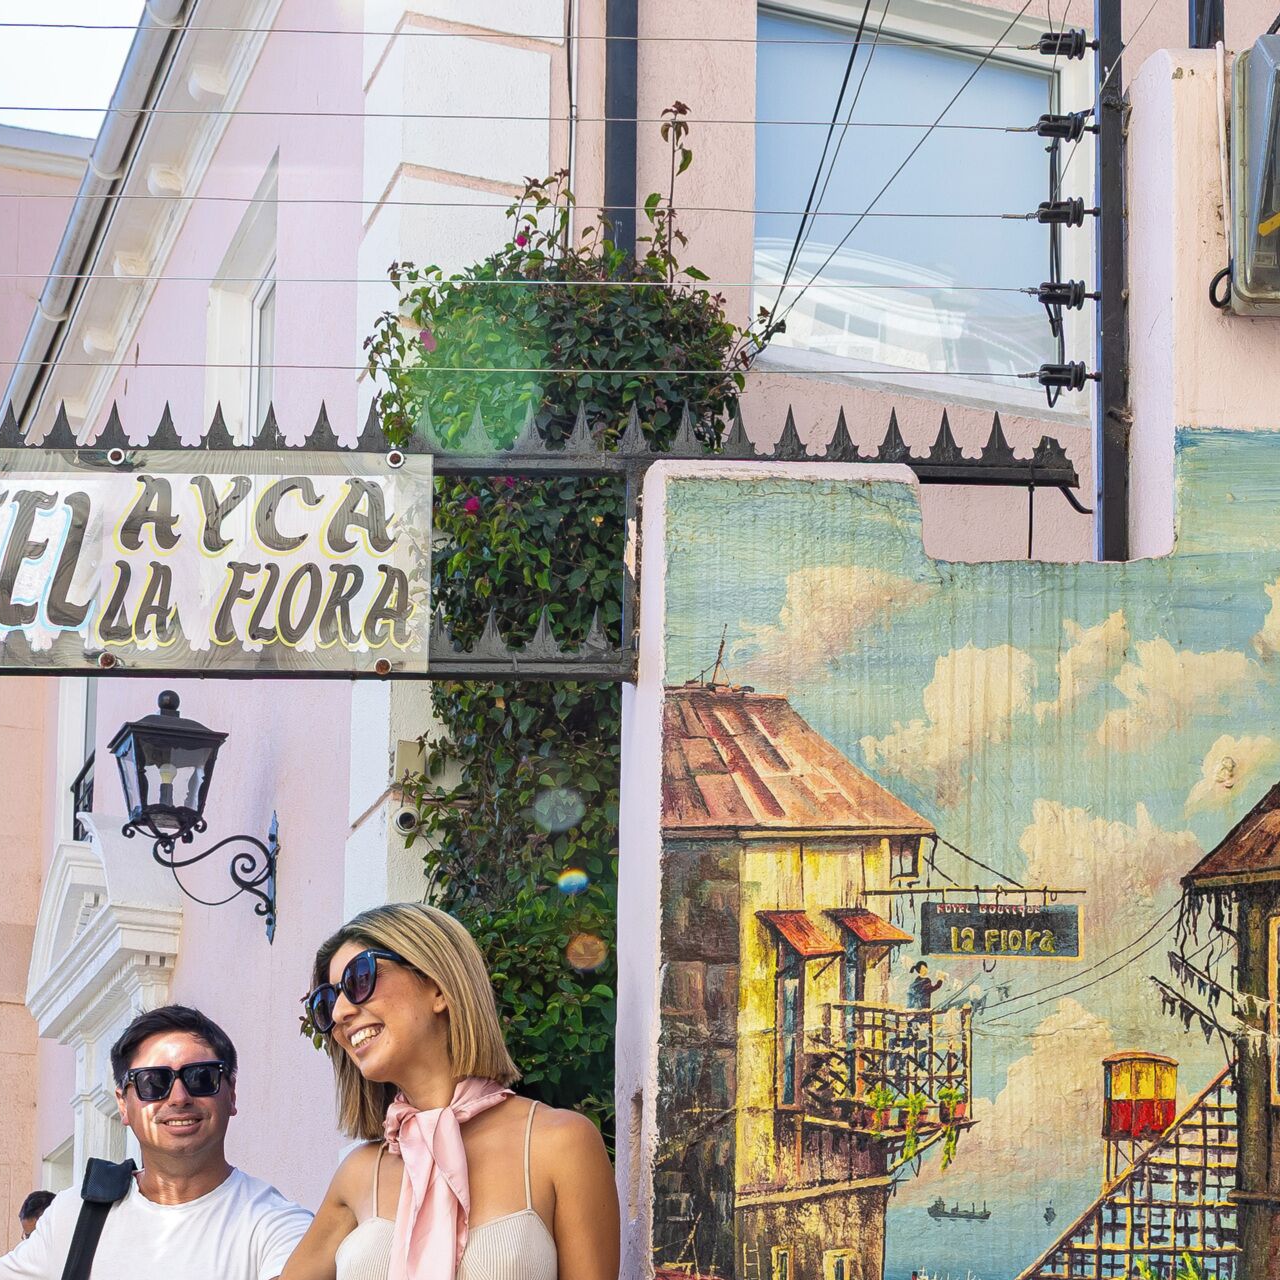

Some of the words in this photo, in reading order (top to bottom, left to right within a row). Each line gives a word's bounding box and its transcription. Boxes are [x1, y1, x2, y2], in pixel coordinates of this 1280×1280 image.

[114, 474, 399, 555] AYCA
[96, 561, 177, 644] LA
[209, 561, 412, 646] FLORA
